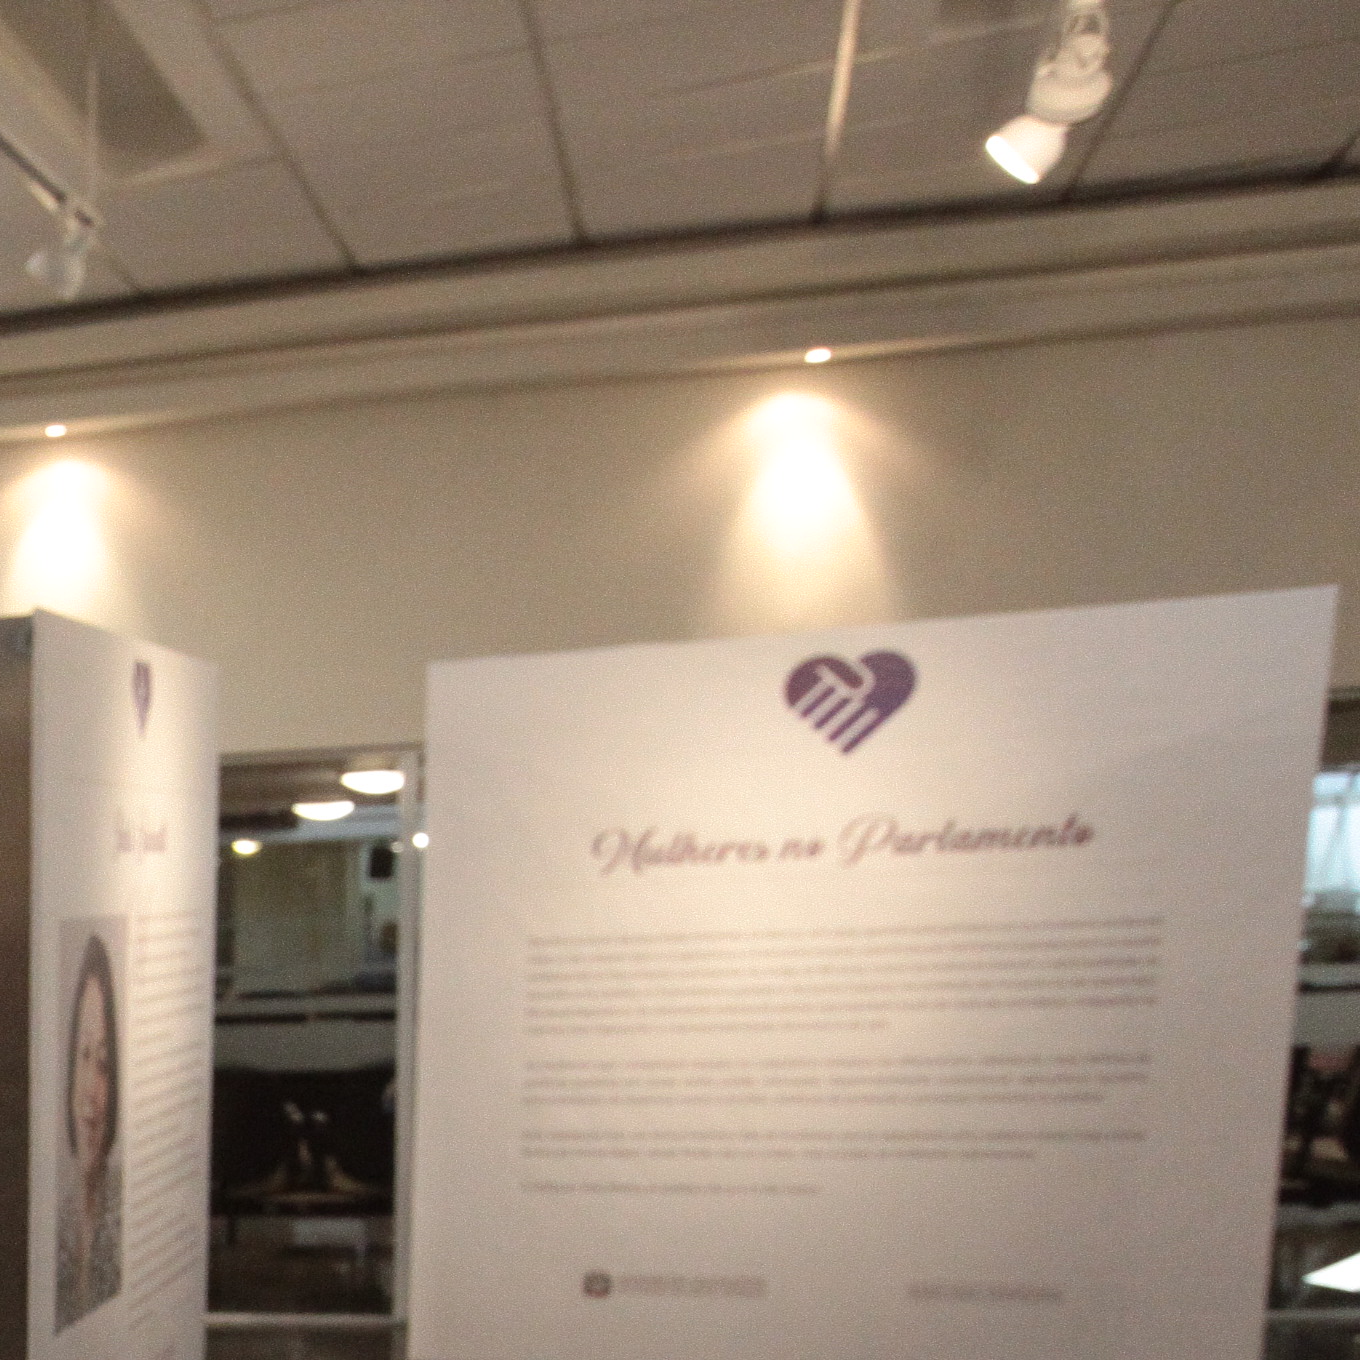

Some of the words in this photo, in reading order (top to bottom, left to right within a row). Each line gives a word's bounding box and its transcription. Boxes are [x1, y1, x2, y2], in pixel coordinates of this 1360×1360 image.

[590, 827, 771, 875] Mulheres
[779, 837, 822, 861] no
[837, 810, 1095, 869] Parlamento
